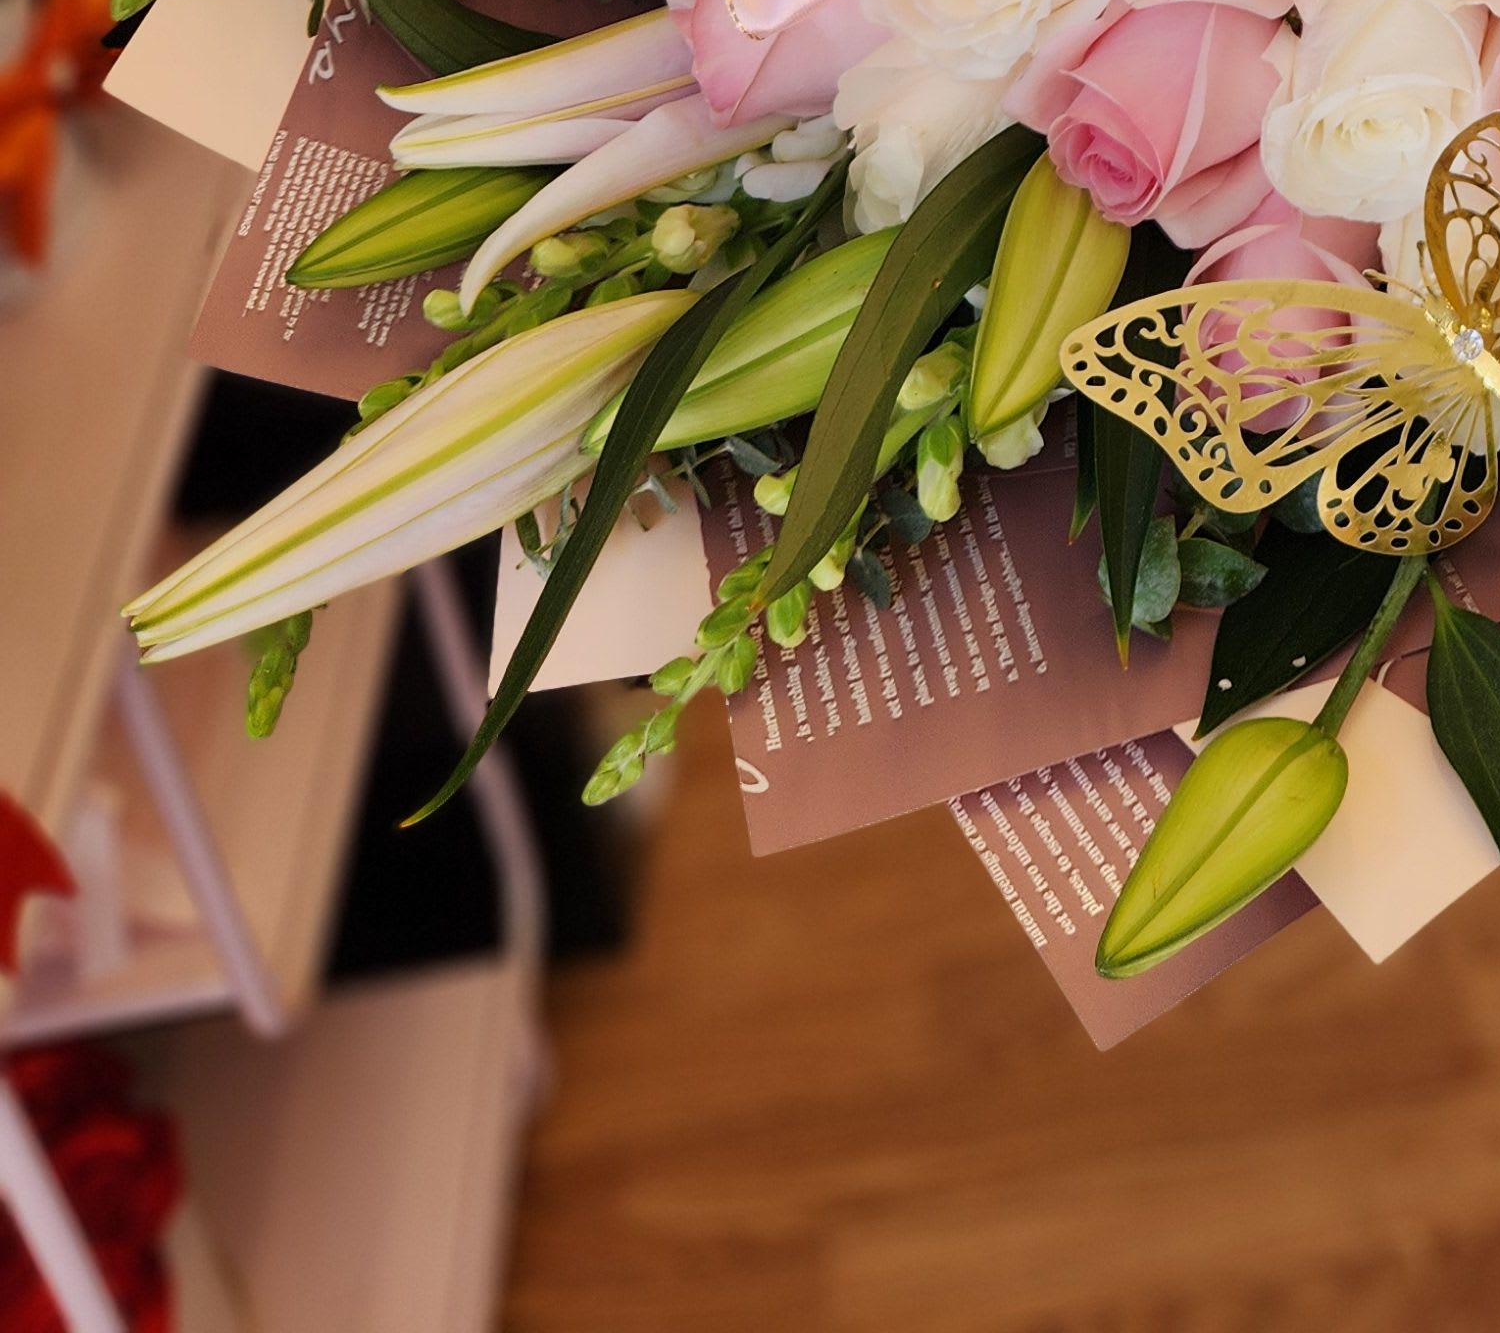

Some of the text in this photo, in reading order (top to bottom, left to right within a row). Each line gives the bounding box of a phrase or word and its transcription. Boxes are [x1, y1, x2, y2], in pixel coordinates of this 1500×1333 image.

[1103, 759, 1138, 807] foreign
[1016, 792, 1036, 816] the
[981, 792, 1032, 867] unfortunate
[1030, 813, 1063, 856] escape
[1107, 821, 1132, 850] new
[1057, 855, 1072, 873] to
[1027, 865, 1049, 892] two
[1043, 890, 1063, 915] the
